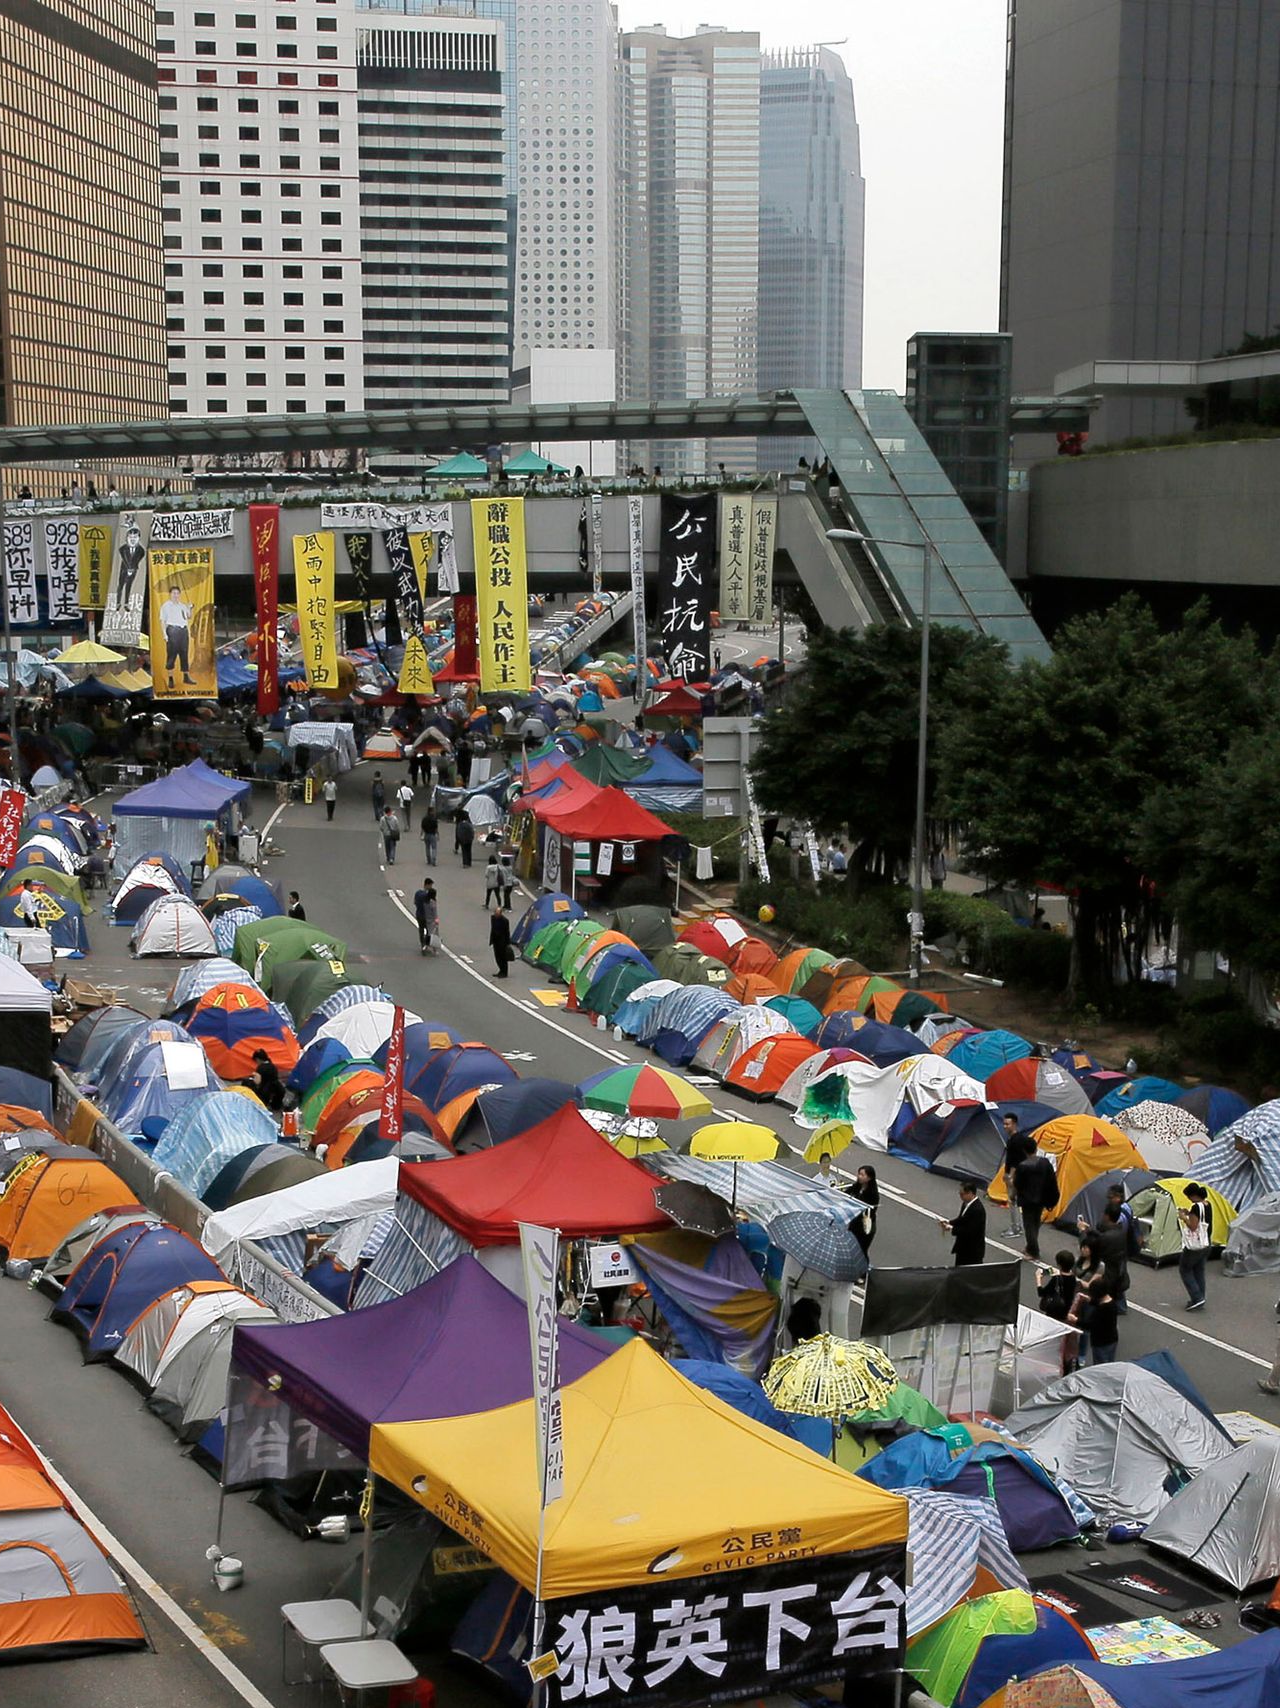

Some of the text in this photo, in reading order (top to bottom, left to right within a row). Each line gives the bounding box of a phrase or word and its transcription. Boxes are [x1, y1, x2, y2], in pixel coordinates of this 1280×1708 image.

[303, 533, 330, 685] 風雨中抱緊自由
[668, 509, 707, 685] 公民抗命
[57, 1172, 97, 1206] 64
[433, 1504, 492, 1554] CIVIC PARTY
[721, 1527, 803, 1555] 公民黨
[702, 1545, 818, 1574] CIVIC PARTY
[557, 1571, 908, 1702] 狼英下台
